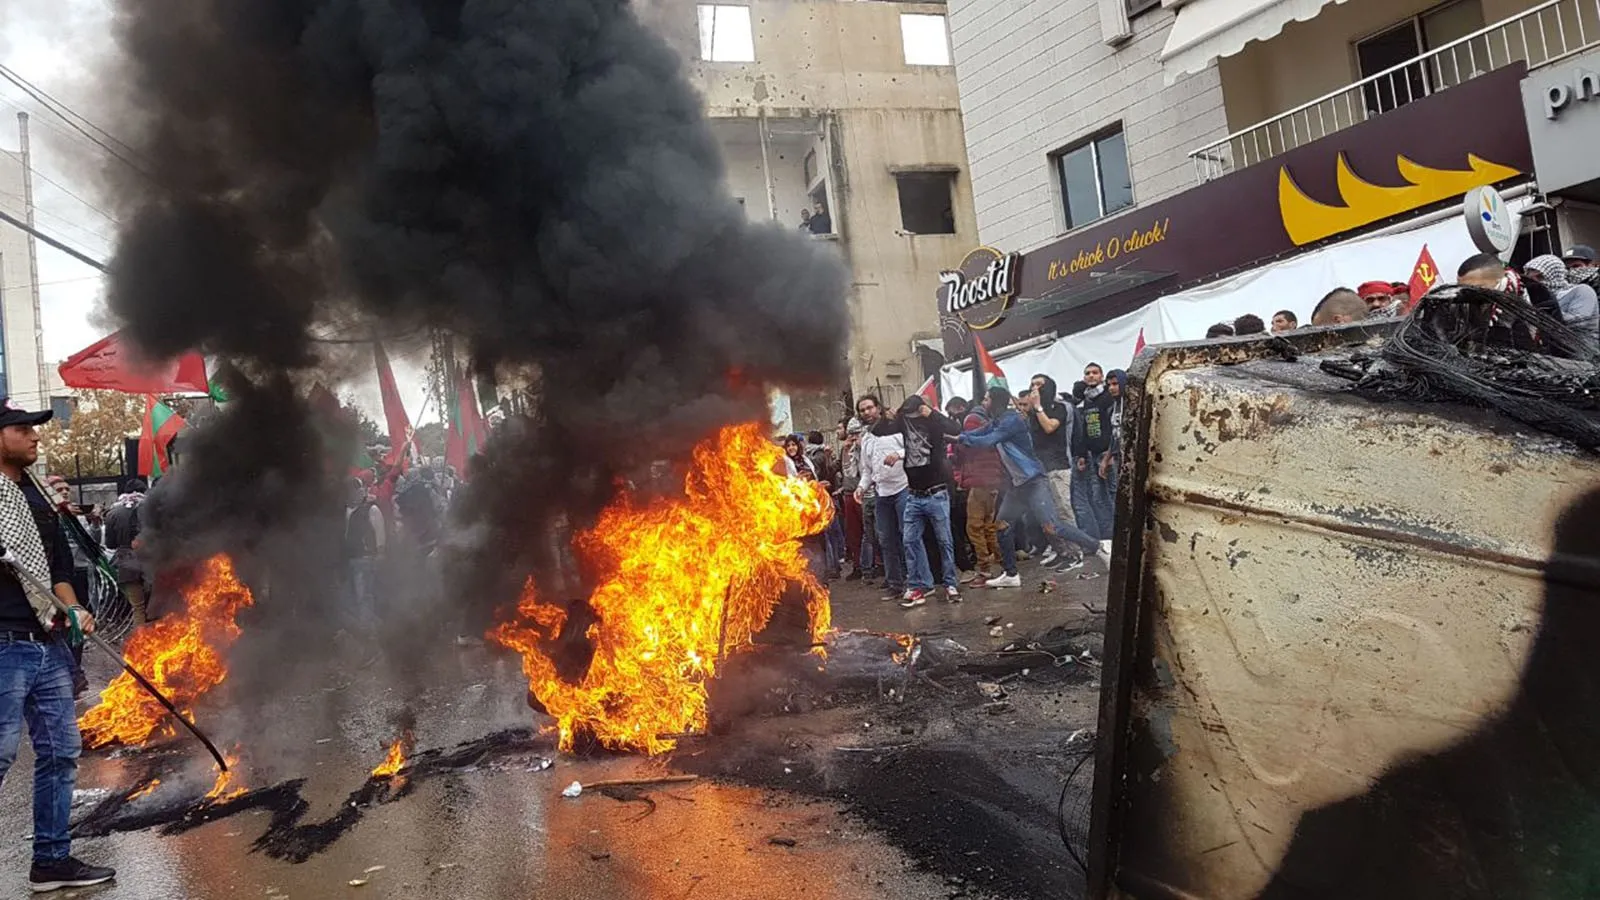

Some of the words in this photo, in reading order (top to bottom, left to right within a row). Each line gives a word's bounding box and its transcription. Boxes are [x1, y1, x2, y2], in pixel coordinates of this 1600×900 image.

[940, 255, 1010, 312] Roost'd
[1048, 260, 1068, 281] It's
[1070, 242, 1104, 272] chick
